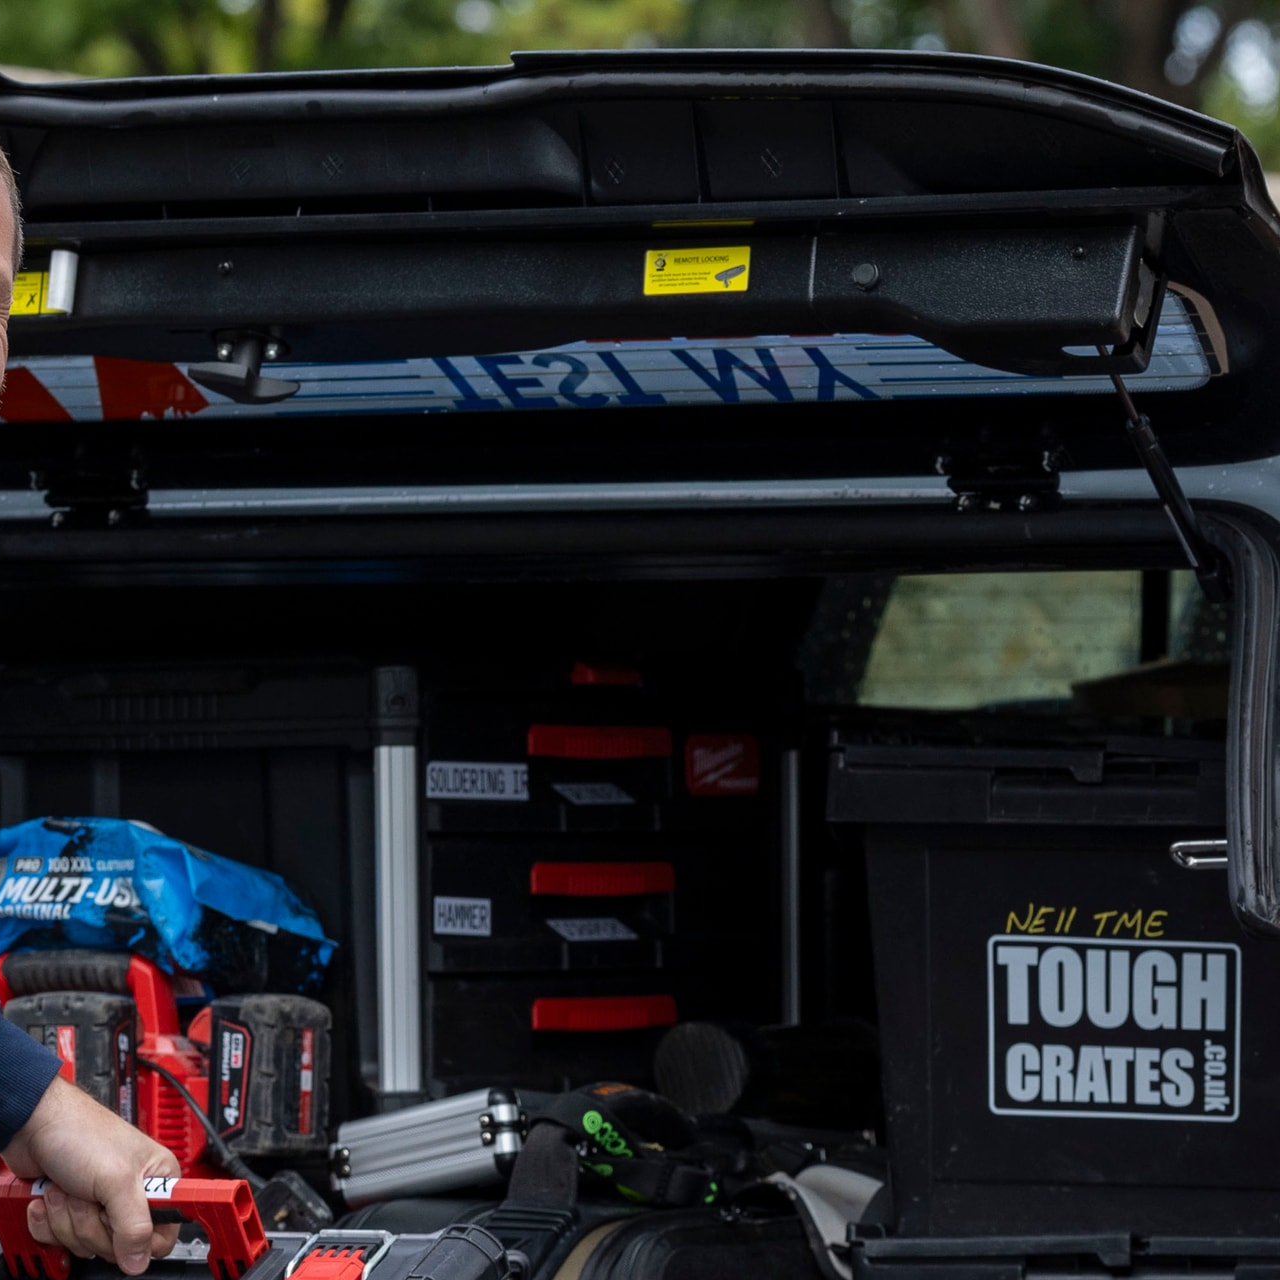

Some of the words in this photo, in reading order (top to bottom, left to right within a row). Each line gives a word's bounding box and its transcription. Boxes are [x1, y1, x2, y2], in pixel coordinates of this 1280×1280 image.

[673, 256, 700, 264] REMOTE
[701, 255, 729, 263] LOCKING
[429, 767, 506, 793] SOLDERING
[16, 859, 41, 873] PRO
[48, 857, 70, 873] 100
[436, 904, 490, 930] HAMMER
[1093, 909, 1169, 938] TME
[996, 945, 1228, 1032] TOUGH
[1005, 1042, 1195, 1107] CRATES
[1203, 1039, 1231, 1114] .co.uk
